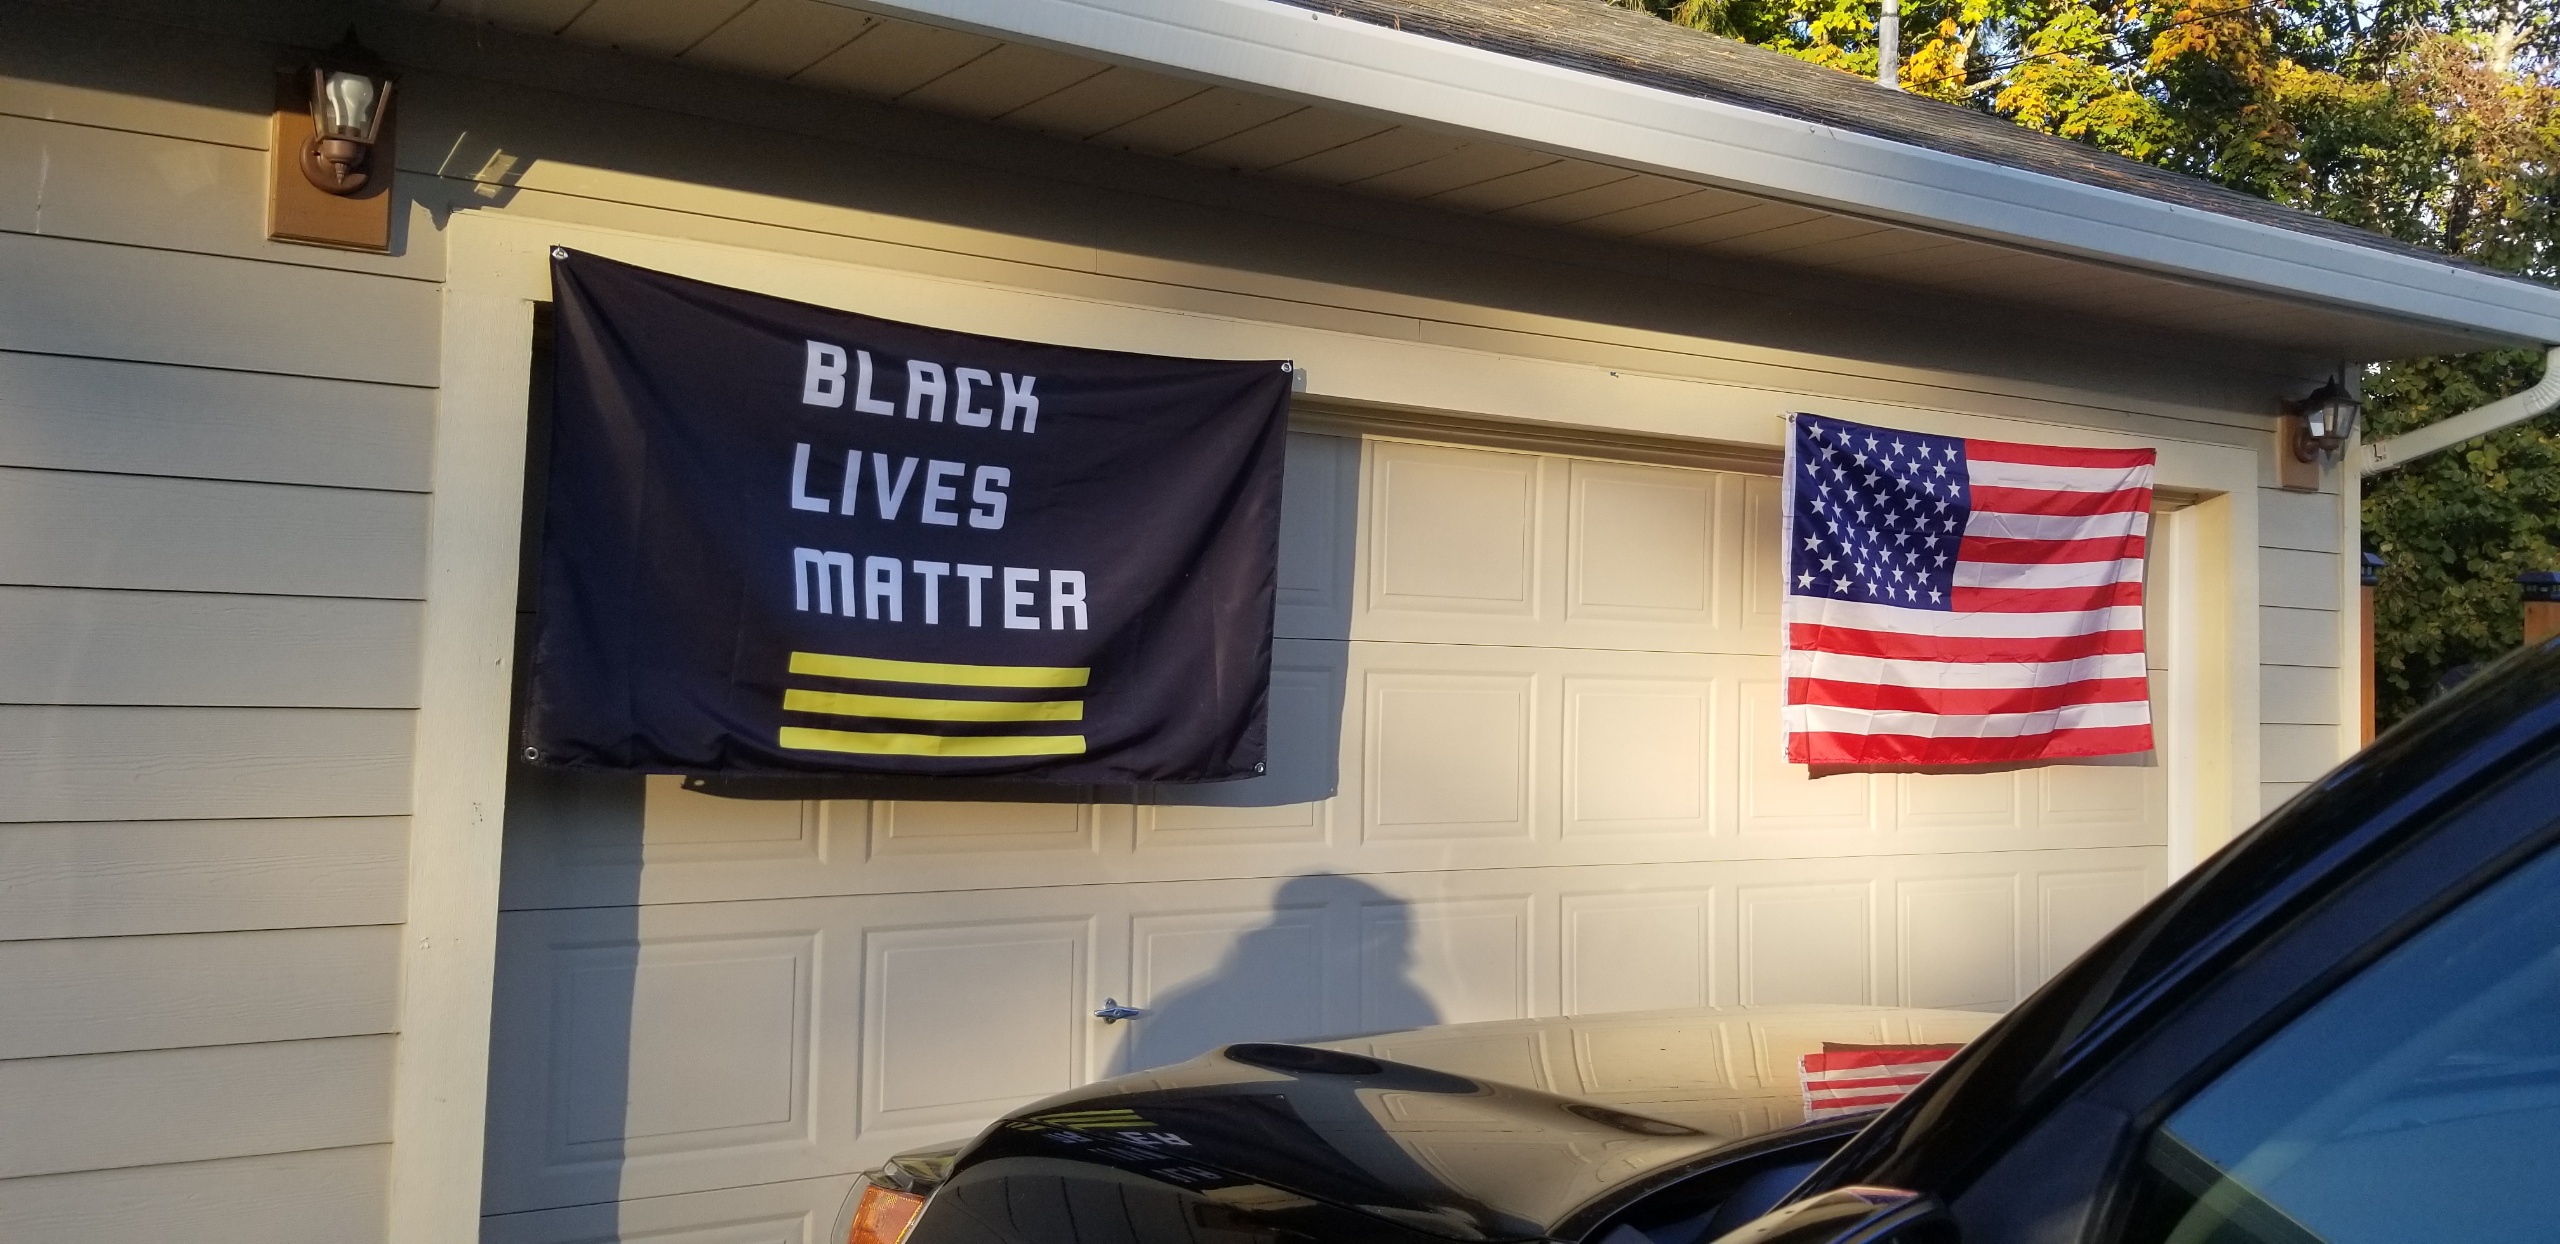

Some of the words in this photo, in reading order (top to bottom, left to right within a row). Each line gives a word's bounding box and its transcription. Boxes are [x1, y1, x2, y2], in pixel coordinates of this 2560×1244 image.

[802, 339, 1040, 434] BLACK
[790, 442, 1012, 530] LIVES
[792, 547, 1089, 631] MATTER
